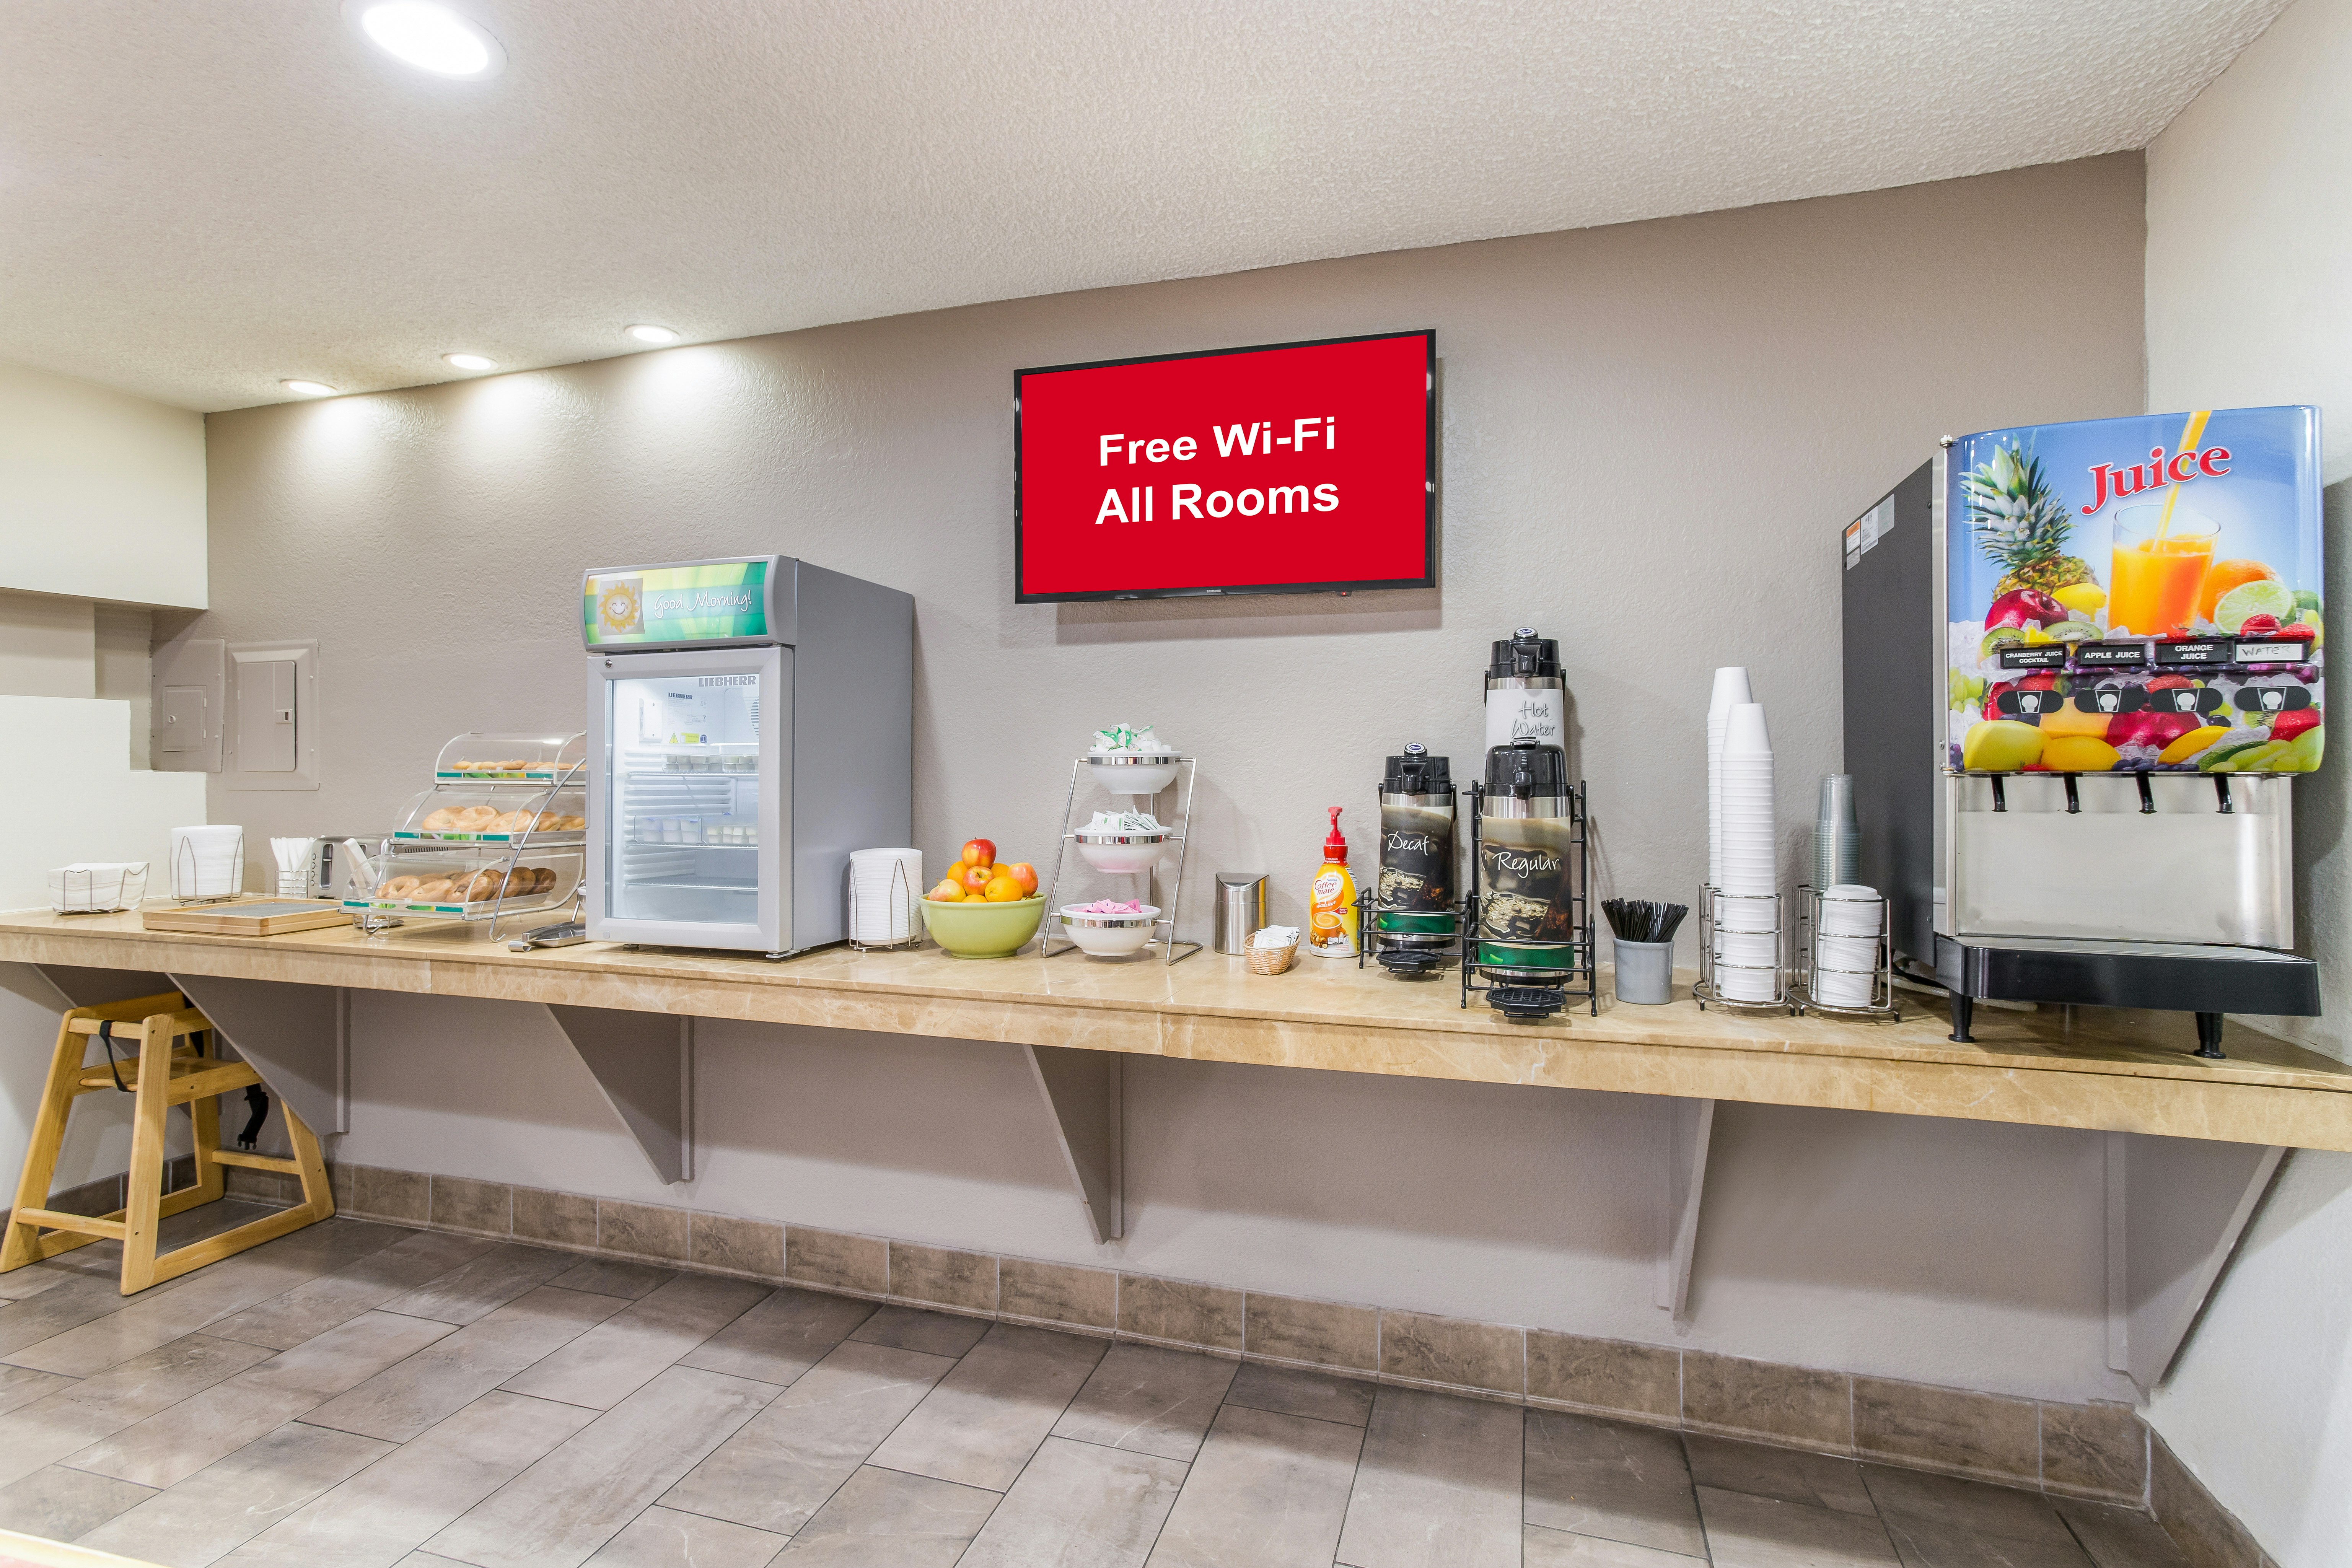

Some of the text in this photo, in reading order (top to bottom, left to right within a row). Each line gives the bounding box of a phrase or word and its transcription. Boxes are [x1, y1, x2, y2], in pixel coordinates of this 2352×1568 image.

[1100, 416, 1335, 466] Free Wi-Fi
[2080, 446, 2231, 516] Juice
[1095, 483, 1339, 524] All Rooms
[653, 589, 752, 619] Good Morning!
[699, 676, 757, 687] LIEBHERR
[1518, 700, 1549, 719] Hot
[1511, 719, 1556, 739] Water
[1388, 830, 1430, 856] Decaf
[1492, 852, 1559, 878] Regular
[1314, 879, 1337, 890] Coffee
[1316, 900, 1337, 909] HAZELNUT
